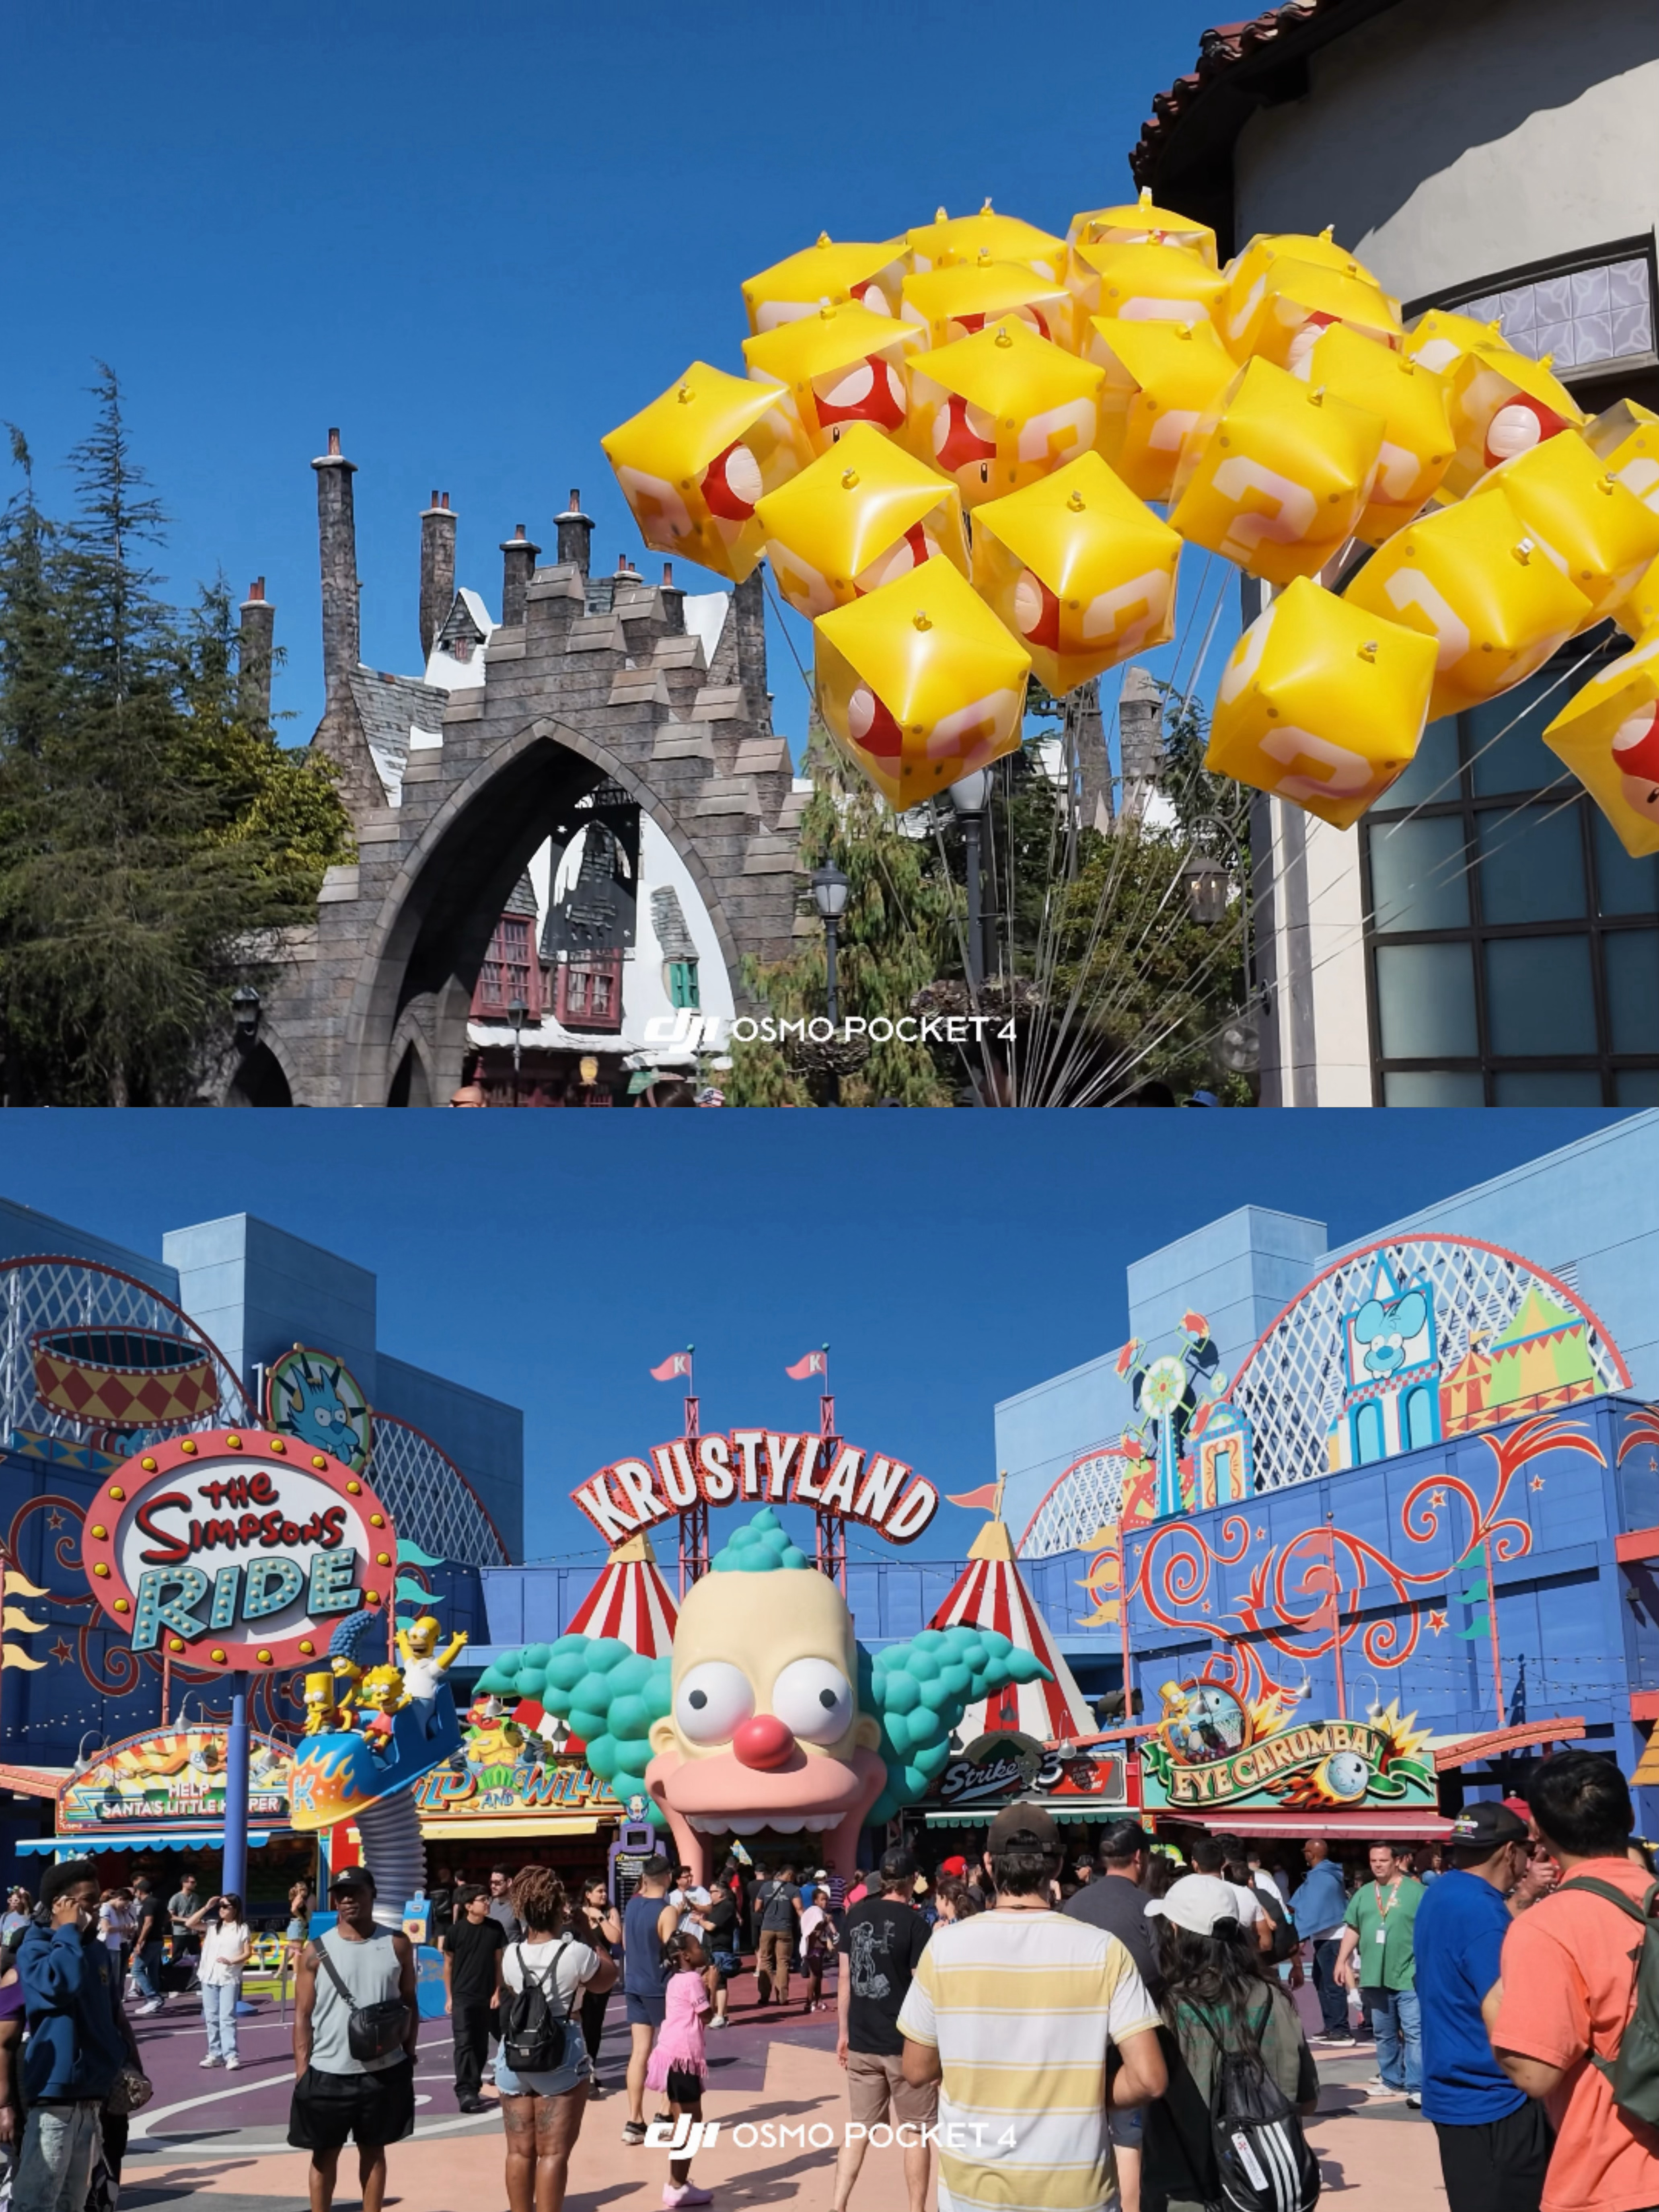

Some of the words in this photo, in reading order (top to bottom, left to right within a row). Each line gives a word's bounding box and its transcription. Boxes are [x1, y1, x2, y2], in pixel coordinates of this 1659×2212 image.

[673, 1355, 687, 1374] K
[808, 1353, 822, 1373] K
[572, 1429, 938, 1545] KRUSTYLAND
[131, 1548, 363, 1652] RIDE
[941, 1758, 1020, 1795] Strike
[1036, 1752, 1063, 1784] 3
[1172, 1765, 1233, 1800] EYE
[1231, 1725, 1380, 1787] CARUMBA!
[168, 1782, 211, 1798] HELP
[293, 1774, 316, 1813] K
[481, 1792, 514, 1809] AND
[102, 1800, 163, 1817] SANTA'S
[167, 1800, 218, 1815] LITTLE
[220, 1797, 280, 1813] HPER
